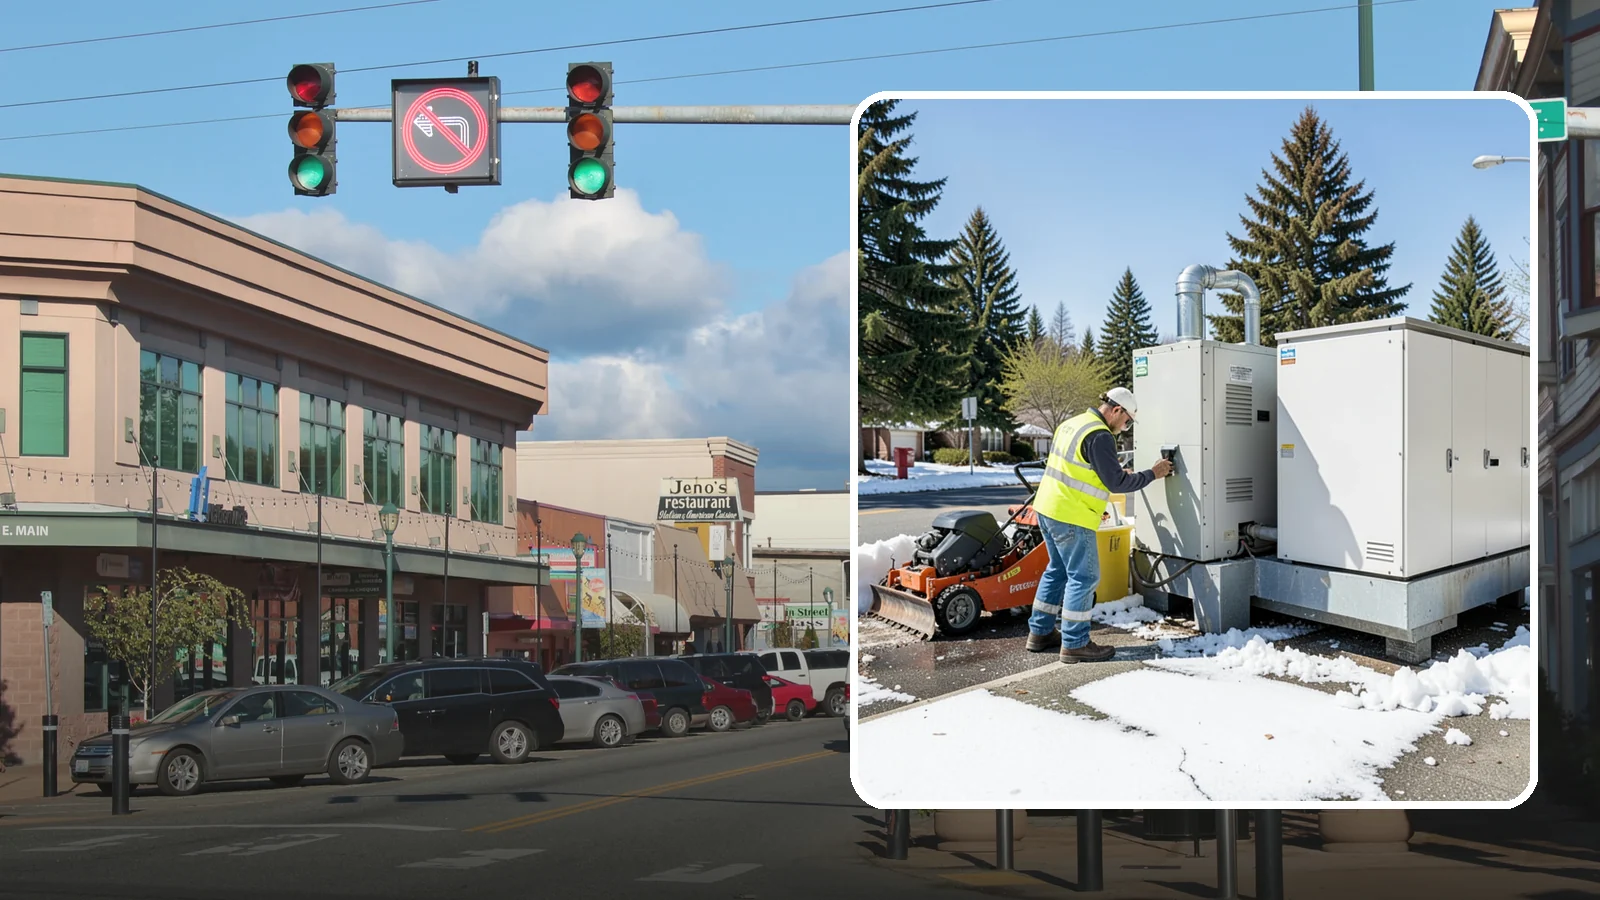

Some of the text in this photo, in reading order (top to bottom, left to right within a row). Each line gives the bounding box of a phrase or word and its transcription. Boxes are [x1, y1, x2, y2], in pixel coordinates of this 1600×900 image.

[670, 480, 728, 494] Jeno's
[665, 496, 731, 509] restaurant
[658, 510, 680, 519] Italian
[686, 509, 714, 519] American
[715, 509, 737, 519] Cuisine
[2, 525, 49, 536] E. MAIN
[797, 607, 828, 616] Street
